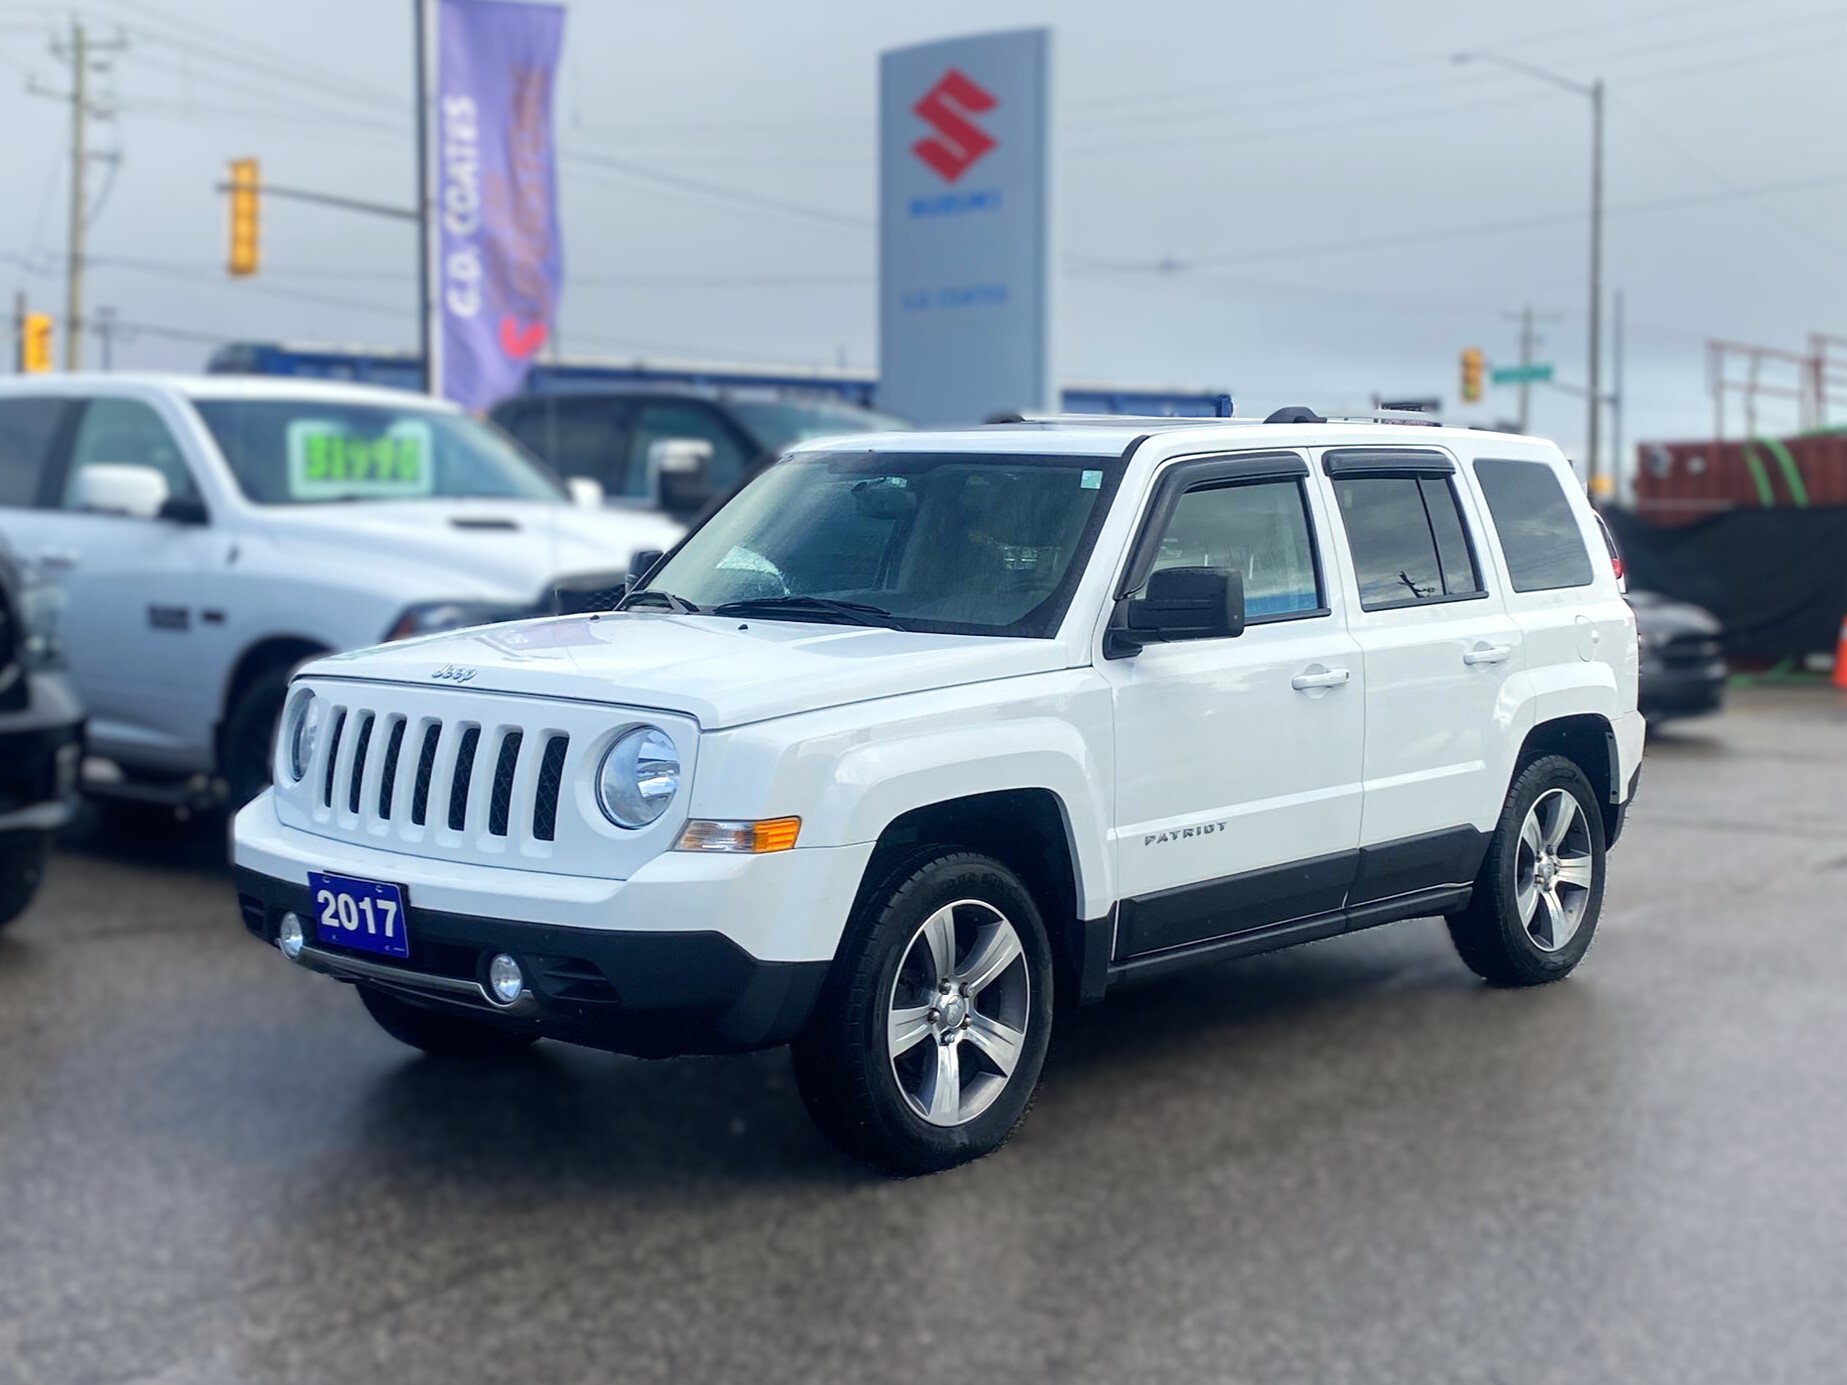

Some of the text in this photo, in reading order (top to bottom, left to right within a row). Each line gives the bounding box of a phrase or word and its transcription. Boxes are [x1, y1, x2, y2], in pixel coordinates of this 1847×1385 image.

[442, 93, 479, 237] COATES
[432, 663, 477, 683] Jeep
[1144, 821, 1228, 847] PATRIOT
[317, 889, 397, 937] 2017
